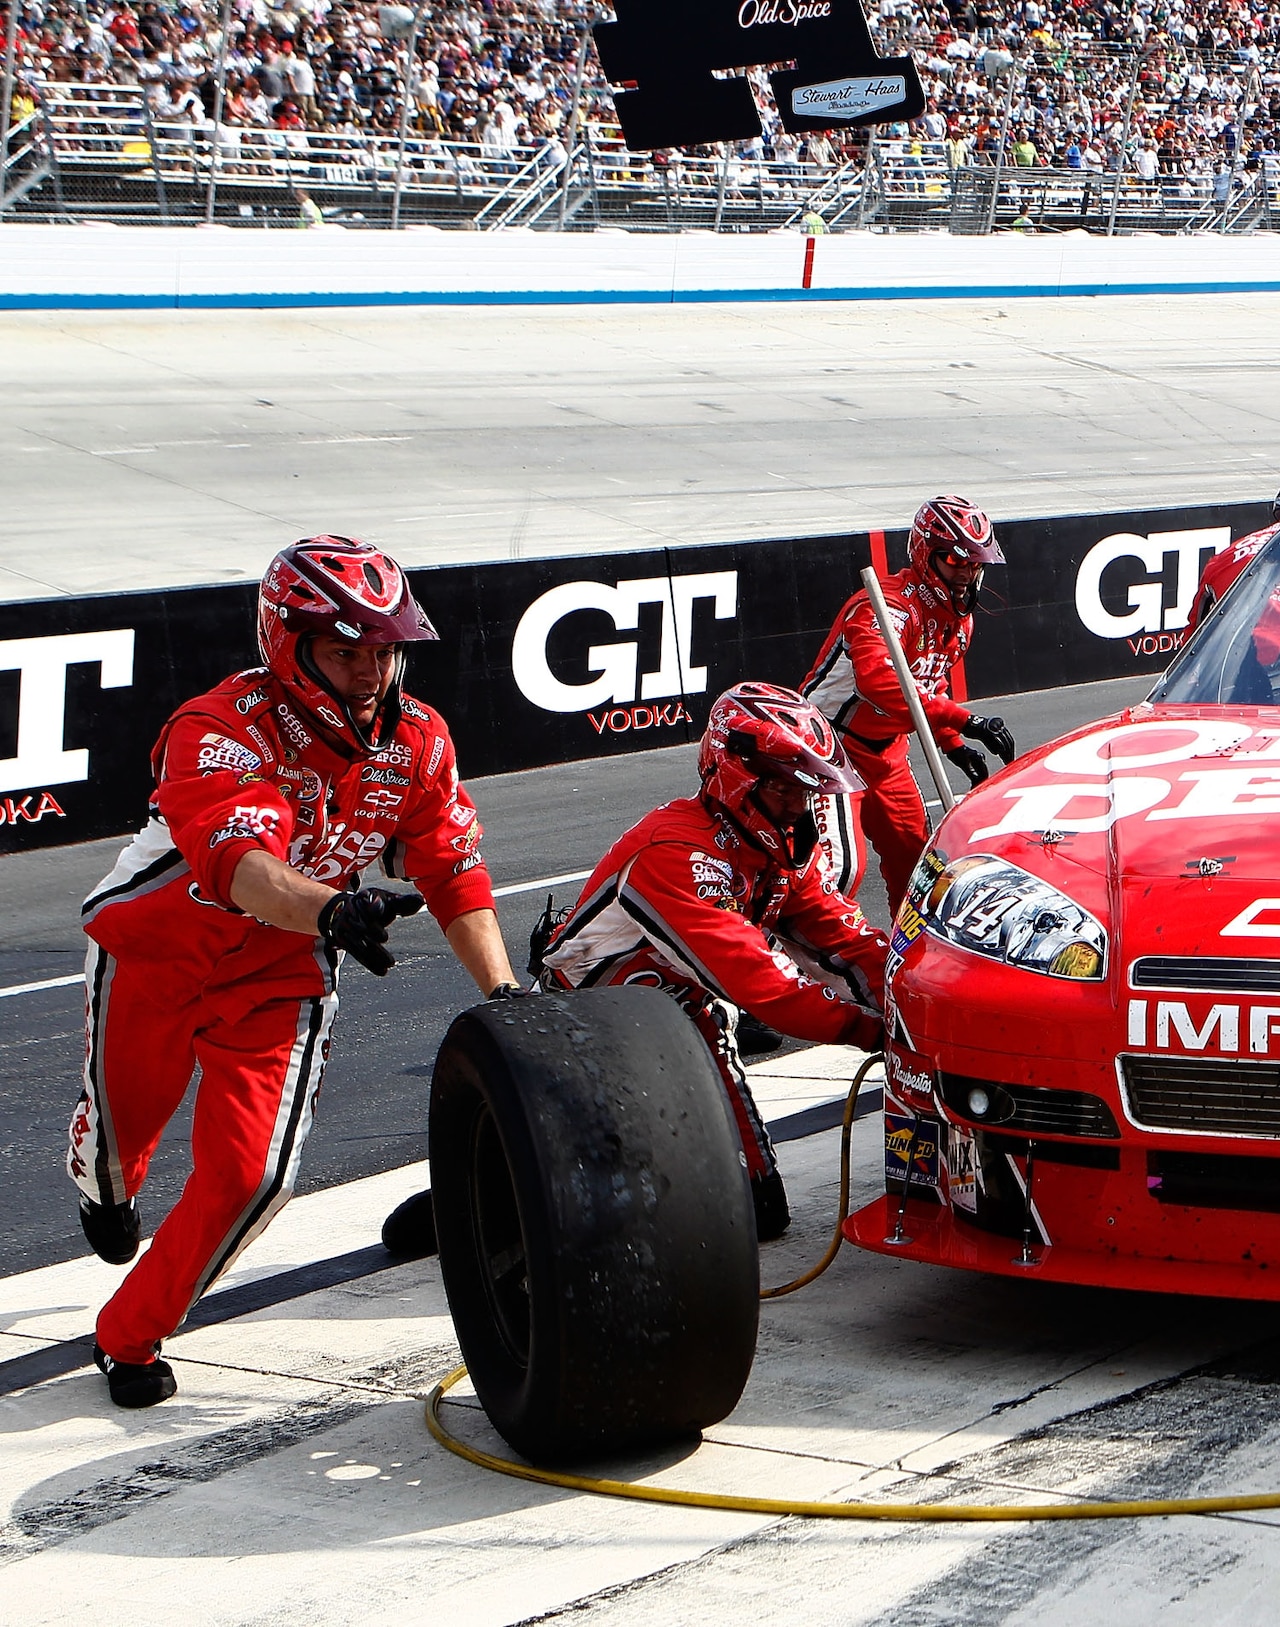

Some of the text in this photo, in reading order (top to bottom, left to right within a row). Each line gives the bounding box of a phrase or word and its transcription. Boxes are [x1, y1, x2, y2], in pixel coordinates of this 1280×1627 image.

[738, 0, 832, 28] Old Spice
[796, 85, 857, 105] Stewart
[865, 80, 900, 97] Haas
[1075, 526, 1232, 640] GT
[511, 570, 738, 713] GT
[1127, 631, 1186, 657] VODK
[277, 703, 312, 745] Office
[587, 703, 693, 735] VODKA
[246, 725, 274, 763] SIMPSON
[375, 752, 412, 768] EPOT
[388, 739, 412, 757] ice
[427, 735, 445, 777] SIMPSON
[946, 886, 1022, 940] 14
[892, 1057, 932, 1094] Raybestos
